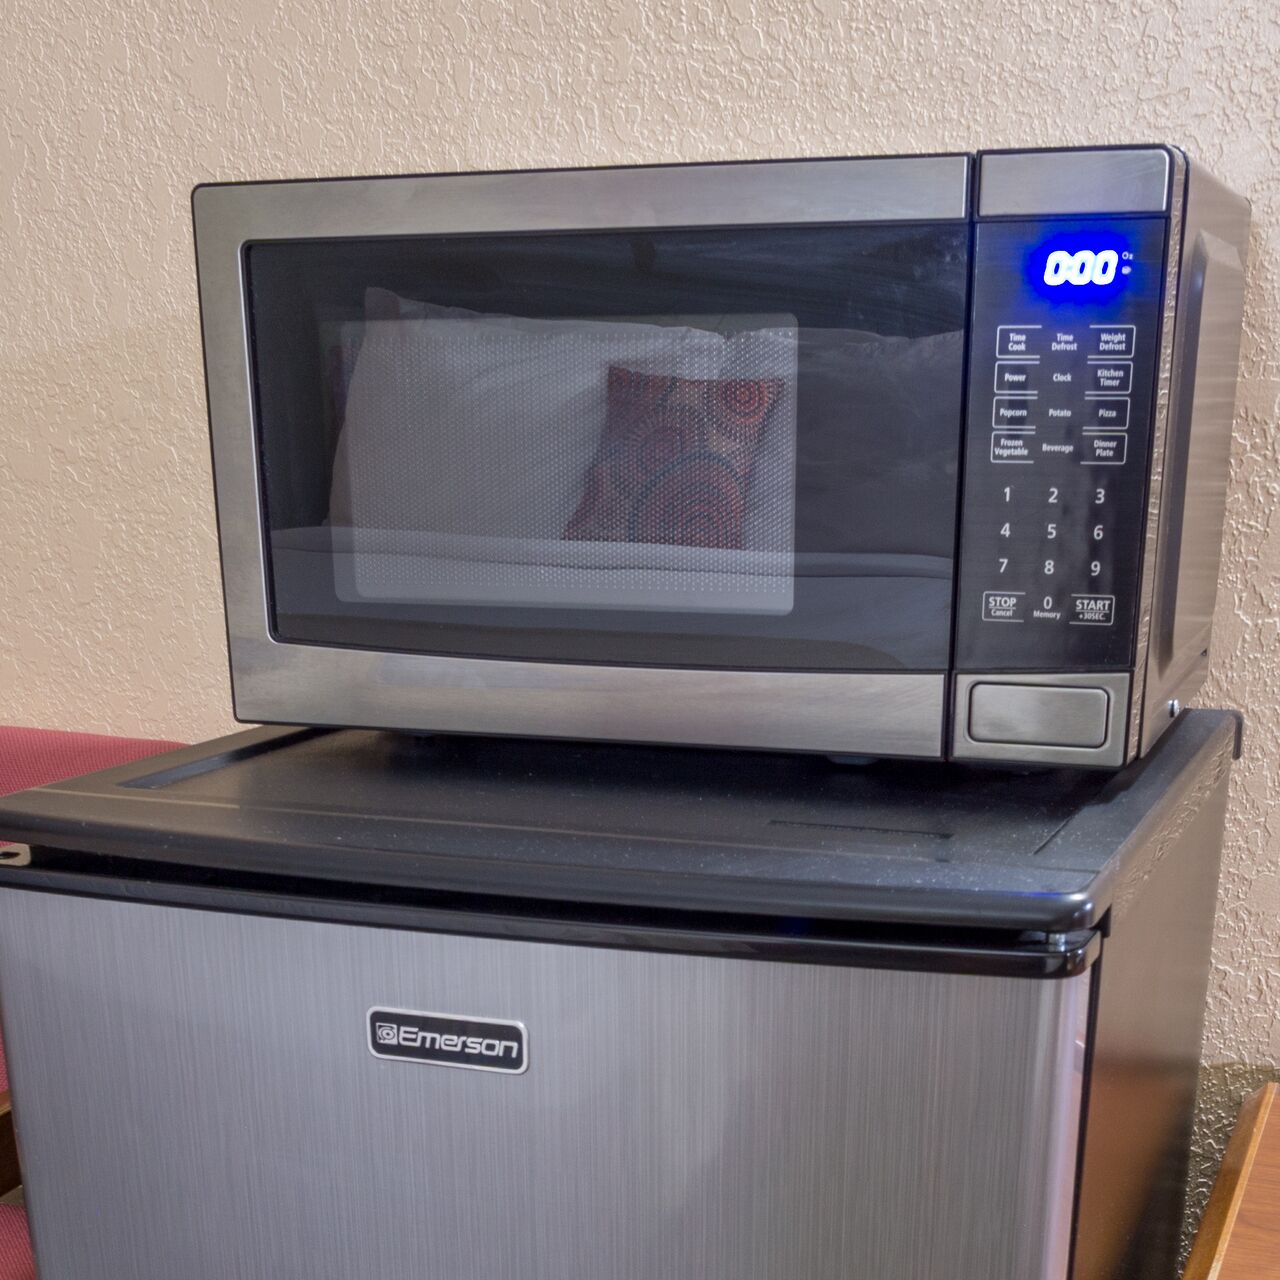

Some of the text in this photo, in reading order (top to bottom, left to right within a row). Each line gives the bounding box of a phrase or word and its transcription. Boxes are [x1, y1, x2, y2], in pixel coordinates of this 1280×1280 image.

[1009, 333, 1026, 342] Time
[1057, 333, 1073, 342] Time
[1101, 333, 1126, 343] Weight
[1008, 342, 1026, 351] Cook
[1052, 342, 1077, 351] Defrost
[1099, 342, 1126, 351] Defrost
[1004, 373, 1026, 382] Power
[1053, 373, 1072, 382] Clock
[1098, 369, 1124, 378] Kitchen
[1100, 378, 1120, 387] Timer
[1000, 408, 1027, 418] Popcorn
[1049, 408, 1072, 417] Potato
[1099, 409, 1116, 418] Pizza
[1001, 438, 1023, 447] Frozen
[1094, 439, 1117, 448] Dinner
[995, 447, 1028, 456] Vegetable
[1042, 443, 1073, 453] Beverage
[1096, 448, 1114, 457] Plate
[1003, 487, 1010, 502] 1
[1048, 488, 1058, 504] 2
[1095, 488, 1105, 504] 3
[1000, 522, 1011, 538] 4
[1047, 523, 1057, 539] 5
[1093, 524, 1103, 540] 6
[999, 558, 1008, 573] 7
[1044, 559, 1054, 575] 8
[1090, 561, 1100, 576] 9
[989, 597, 1016, 607] STOP
[1043, 596, 1052, 610] 0
[1076, 599, 1111, 610] START
[991, 609, 1012, 617] Cancel
[1033, 610, 1060, 620] Memory
[399, 1026, 518, 1058] Emerson
